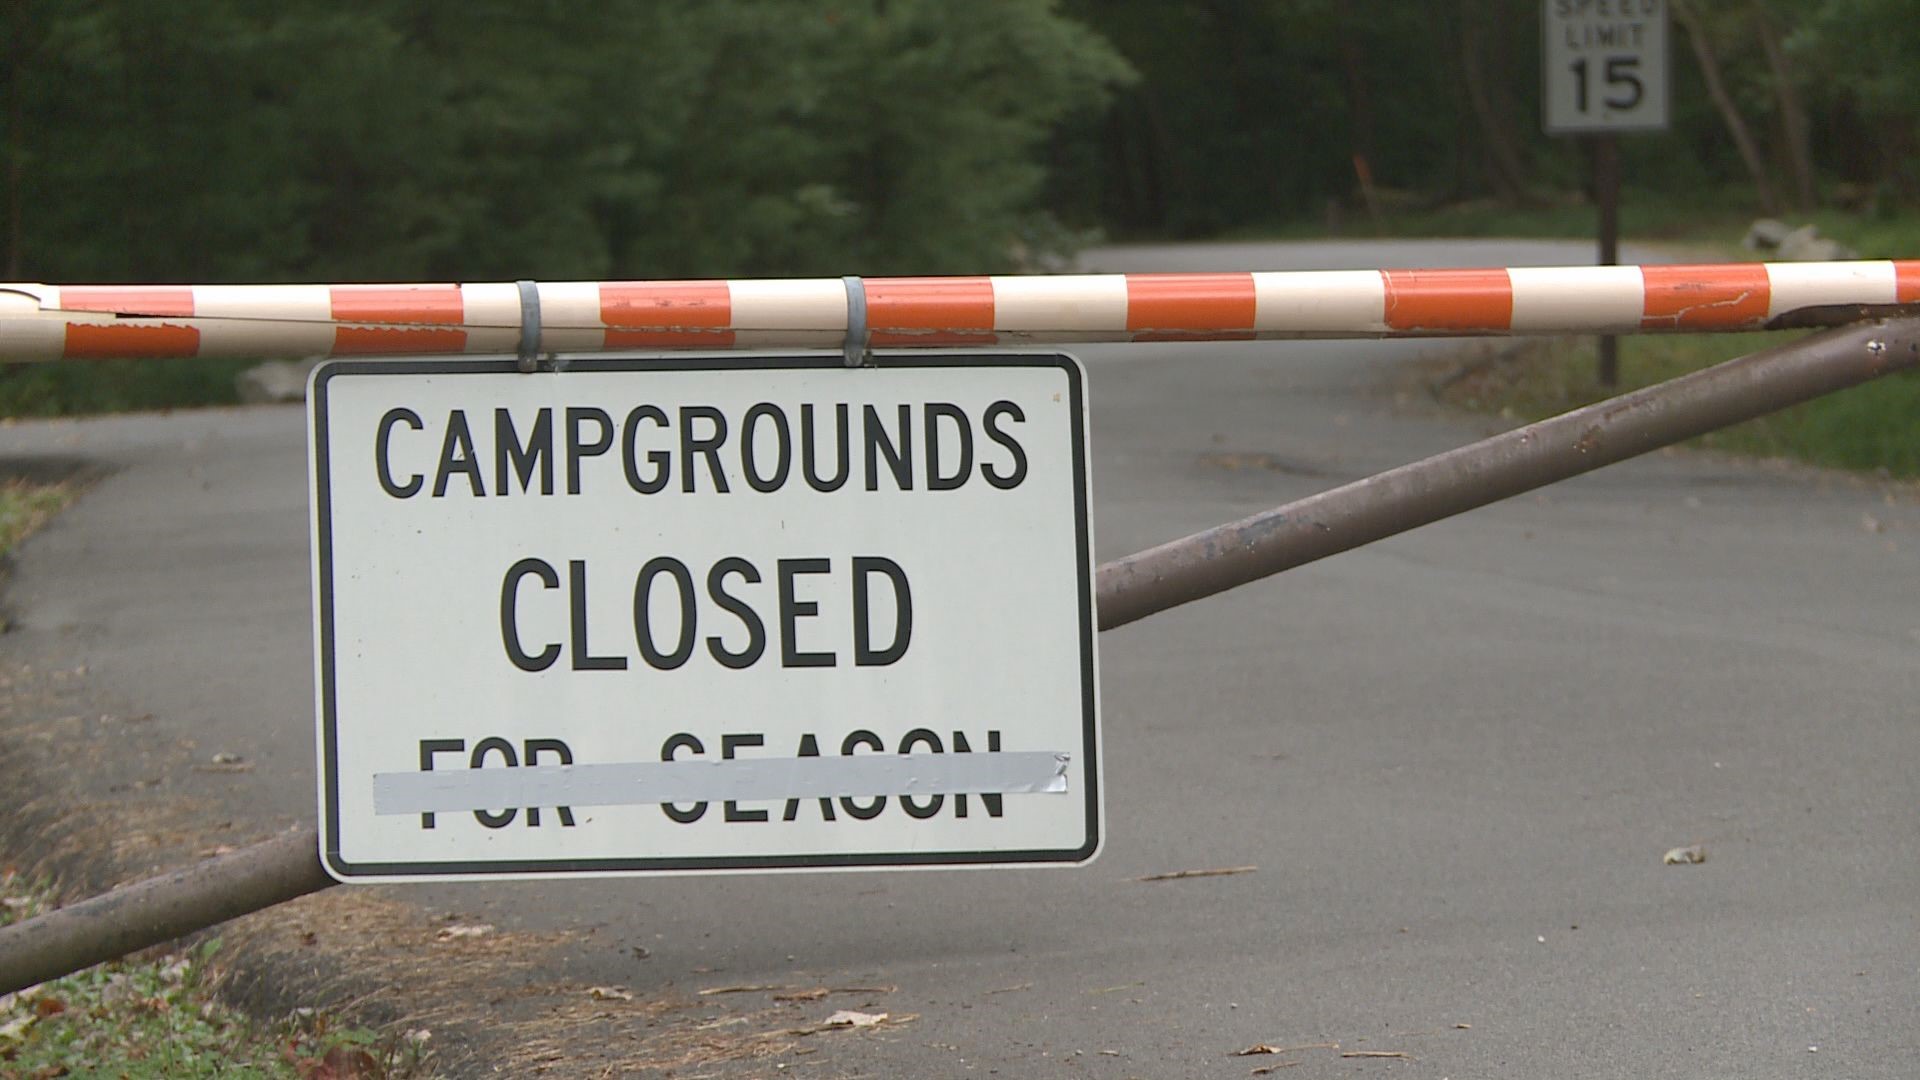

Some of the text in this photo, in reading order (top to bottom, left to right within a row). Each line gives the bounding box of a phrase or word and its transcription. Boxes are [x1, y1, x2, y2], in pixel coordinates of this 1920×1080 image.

[1565, 22, 1645, 48] LIMIT
[1568, 55, 1645, 113] 15
[375, 400, 1028, 499] CAMPGROUNDS
[500, 556, 913, 673] CLOSED
[419, 736, 576, 829] FOR
